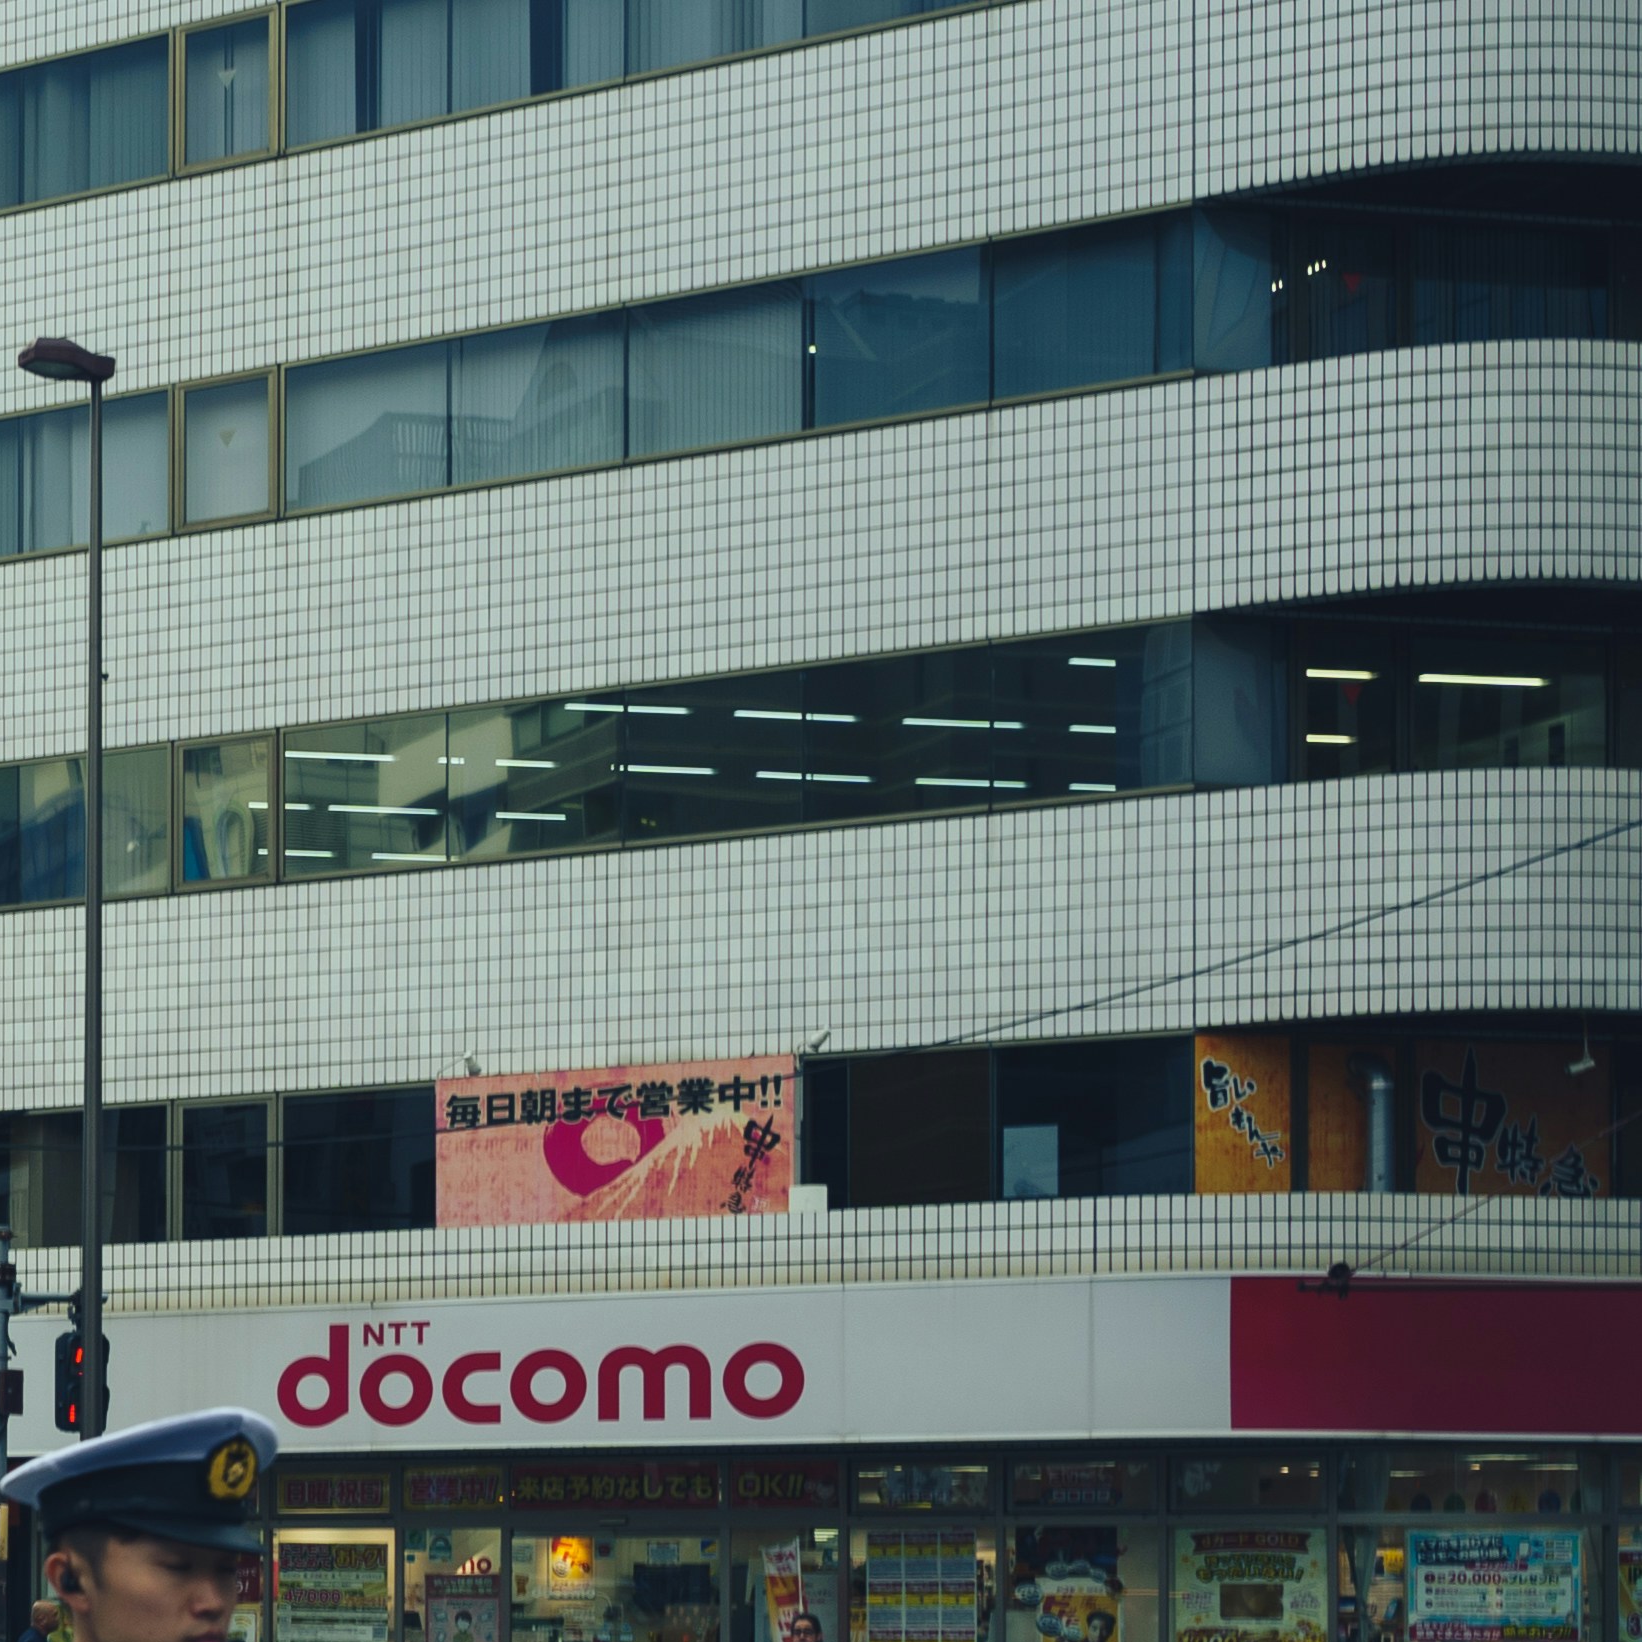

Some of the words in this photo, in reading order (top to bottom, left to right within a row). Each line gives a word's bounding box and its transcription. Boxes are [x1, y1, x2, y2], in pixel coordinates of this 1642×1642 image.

[446, 1073, 784, 1130] 毎日朝まで営業中!!
[1201, 1056, 1284, 1168] 旨いもんや
[1421, 1045, 1599, 1198] 串特急
[720, 1114, 783, 1216] 串特急
[363, 1321, 430, 1346] NTT
[276, 1323, 805, 1429] docomo
[517, 1475, 714, 1502] 来店予約なしでも
[1255, 1534, 1301, 1548] GOLD
